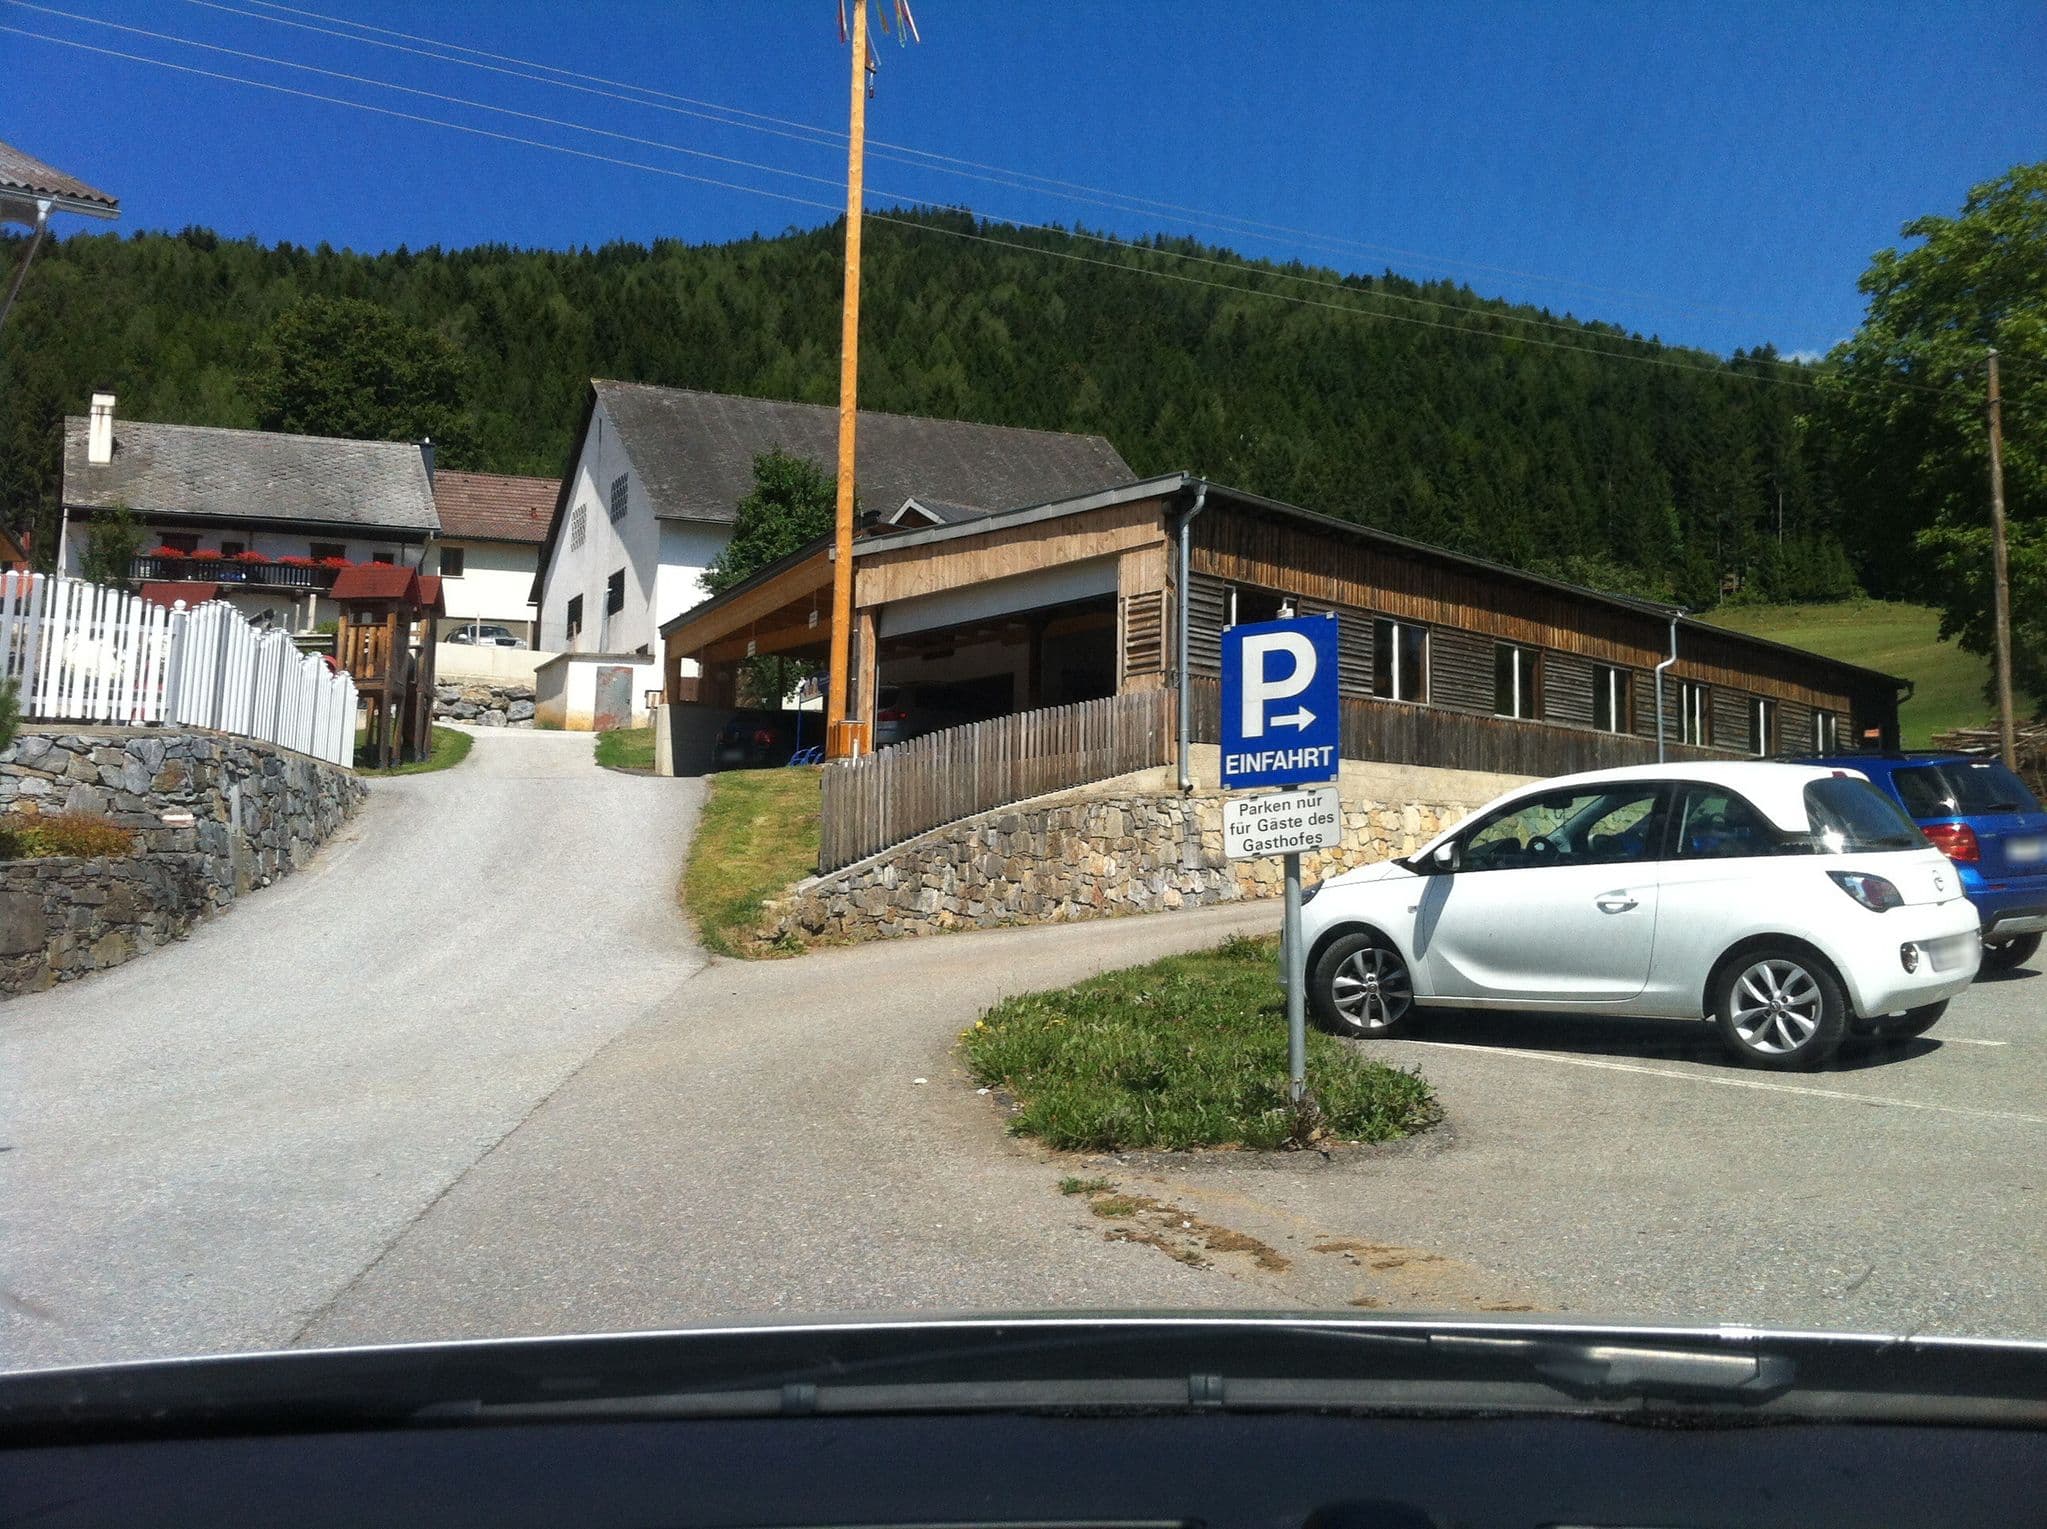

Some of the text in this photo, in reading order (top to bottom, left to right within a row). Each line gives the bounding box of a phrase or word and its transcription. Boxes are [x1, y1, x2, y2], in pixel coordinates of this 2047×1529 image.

[1242, 631, 1317, 738] P
[1226, 746, 1334, 775] EINFAHRT
[1239, 796, 1323, 816] Parken nur
[1230, 812, 1335, 836] für Gäste des
[1243, 831, 1323, 852] Gasthofes
